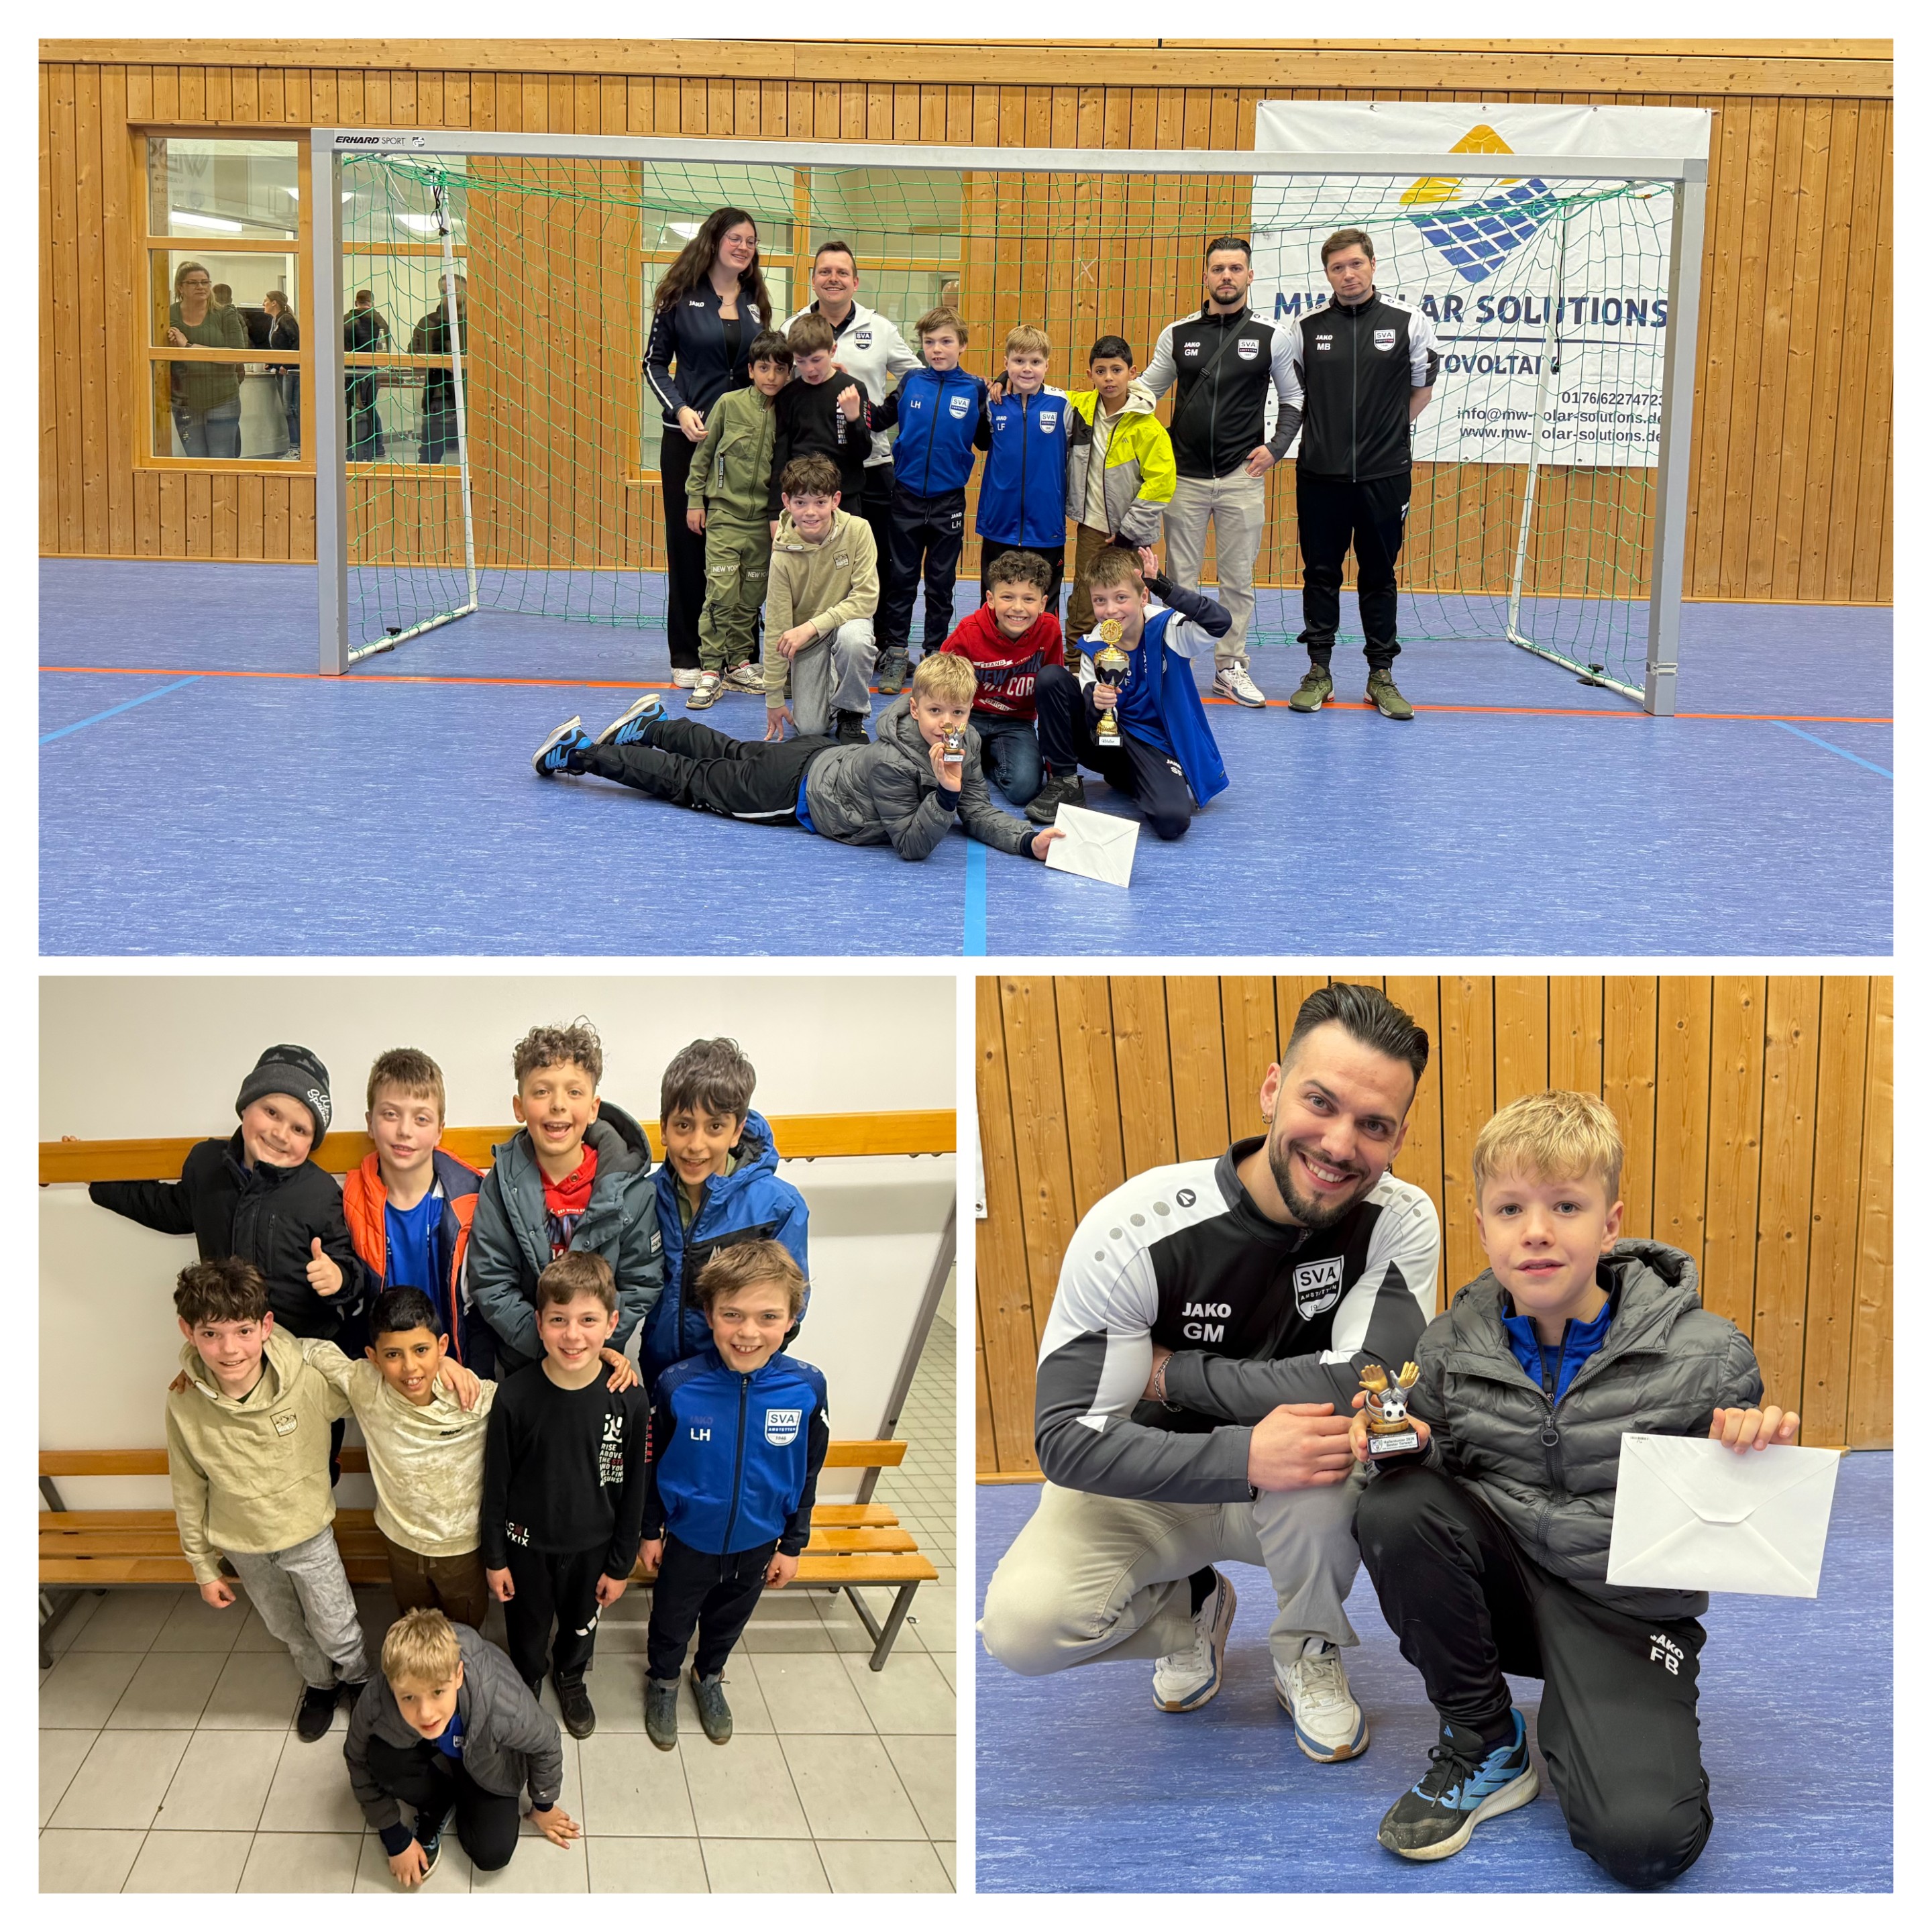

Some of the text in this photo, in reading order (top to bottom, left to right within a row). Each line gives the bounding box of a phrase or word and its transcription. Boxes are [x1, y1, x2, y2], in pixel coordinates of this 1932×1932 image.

[335, 136, 406, 145] ERHARD SPORT
[1476, 295, 1668, 327] SOLUTIONS
[1438, 354, 1560, 374] TOVOLTAI
[910, 400, 921, 409] LH
[953, 398, 967, 407] SVA
[695, 411, 705, 419] W
[1457, 407, 1661, 424] info@mw-olar-solutions.de
[1460, 427, 1660, 442] www.mw-olar-solutions.de
[952, 521, 961, 529] LH
[1007, 677, 1034, 696] COR
[1300, 1267, 1336, 1287] SVA
[1182, 1302, 1232, 1318] JAKO
[1183, 1322, 1224, 1342] GM
[770, 1414, 794, 1424] SVA
[690, 1428, 711, 1441] LH
[600, 1450, 623, 1459] ABOVE
[601, 1443, 616, 1451] RISE
[1650, 1634, 1684, 1660] JAKO
[1650, 1646, 1678, 1675] FB
